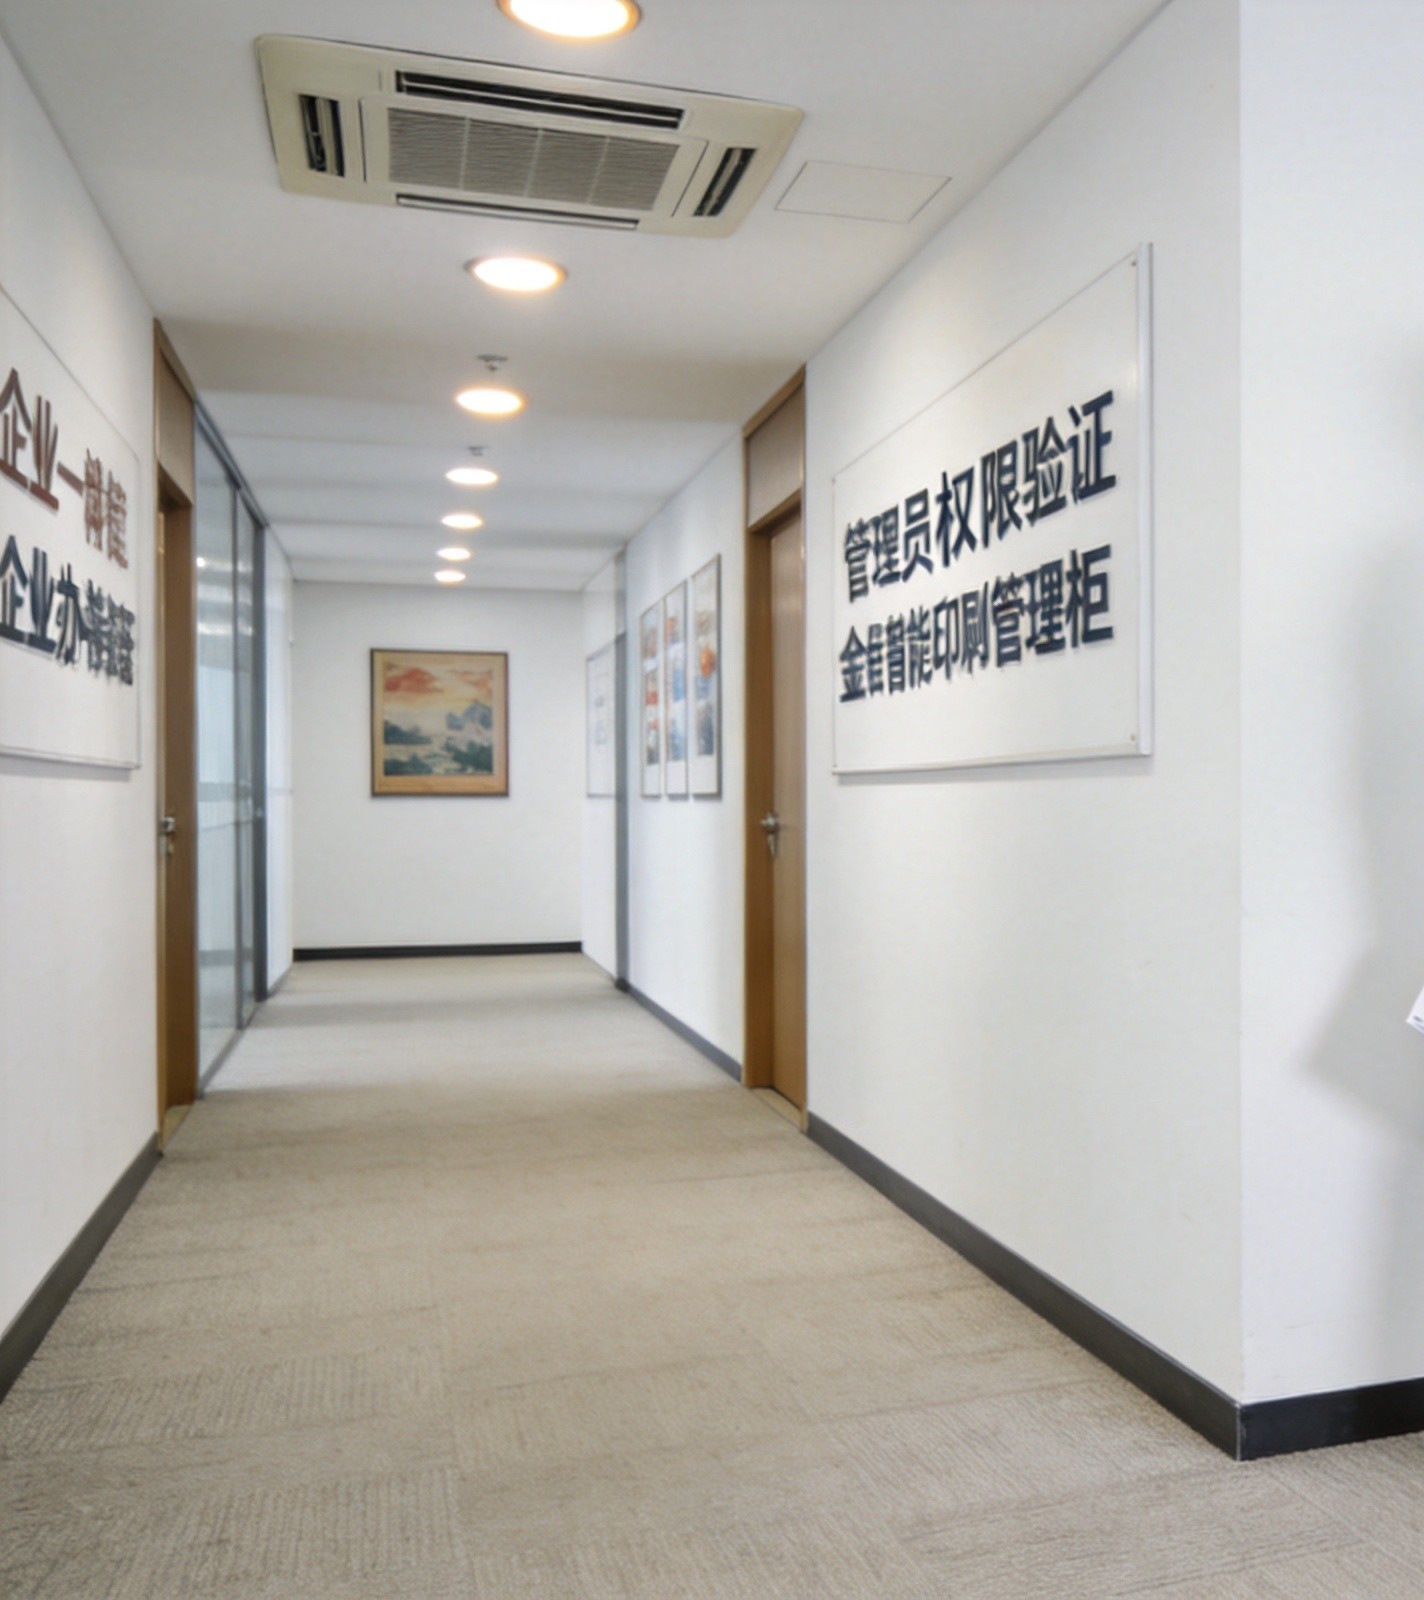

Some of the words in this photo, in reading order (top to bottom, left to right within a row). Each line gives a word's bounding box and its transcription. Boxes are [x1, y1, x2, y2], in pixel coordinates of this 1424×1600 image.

[843, 389, 1117, 603] 管理员权限验证
